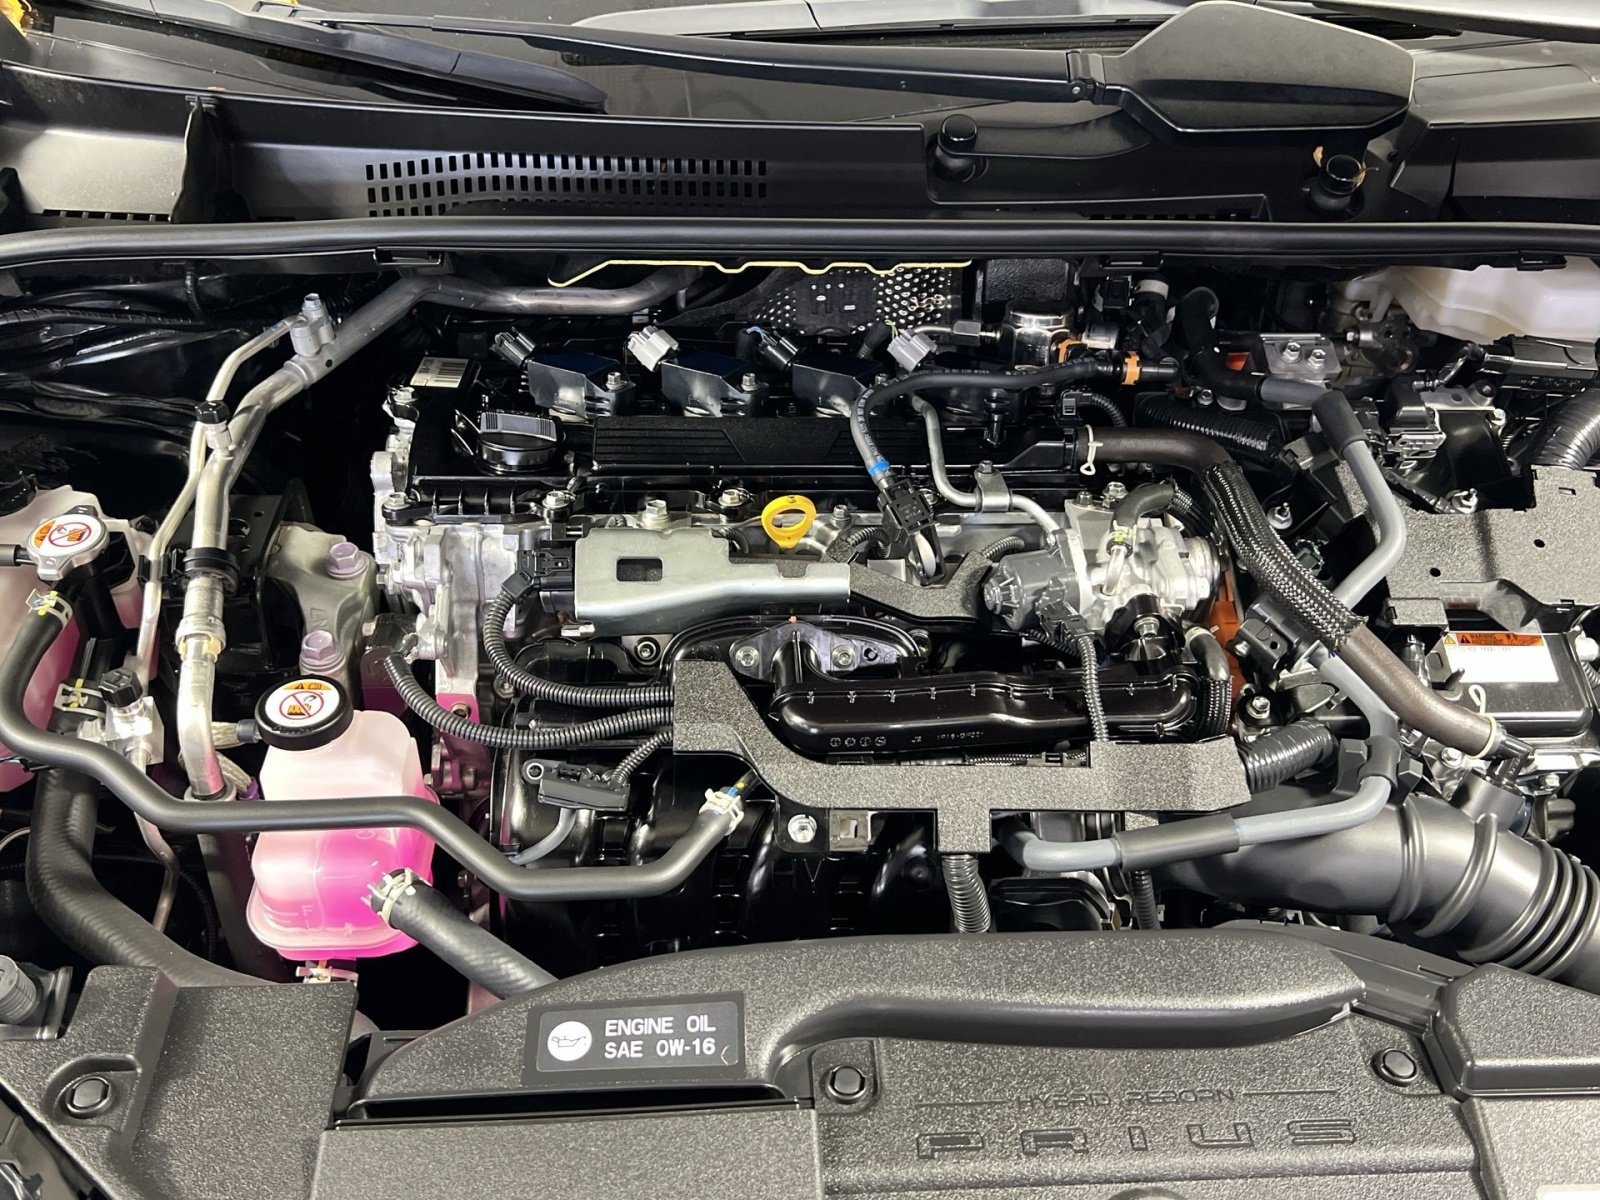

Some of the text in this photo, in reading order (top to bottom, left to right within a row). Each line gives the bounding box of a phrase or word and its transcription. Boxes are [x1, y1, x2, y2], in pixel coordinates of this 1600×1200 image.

[604, 1014, 717, 1037] ENGINE OIL
[604, 1037, 716, 1059] SAE 0W-16
[1017, 1088, 1235, 1108] HYBRID REBORN
[915, 1119, 1356, 1159] PRIUS
